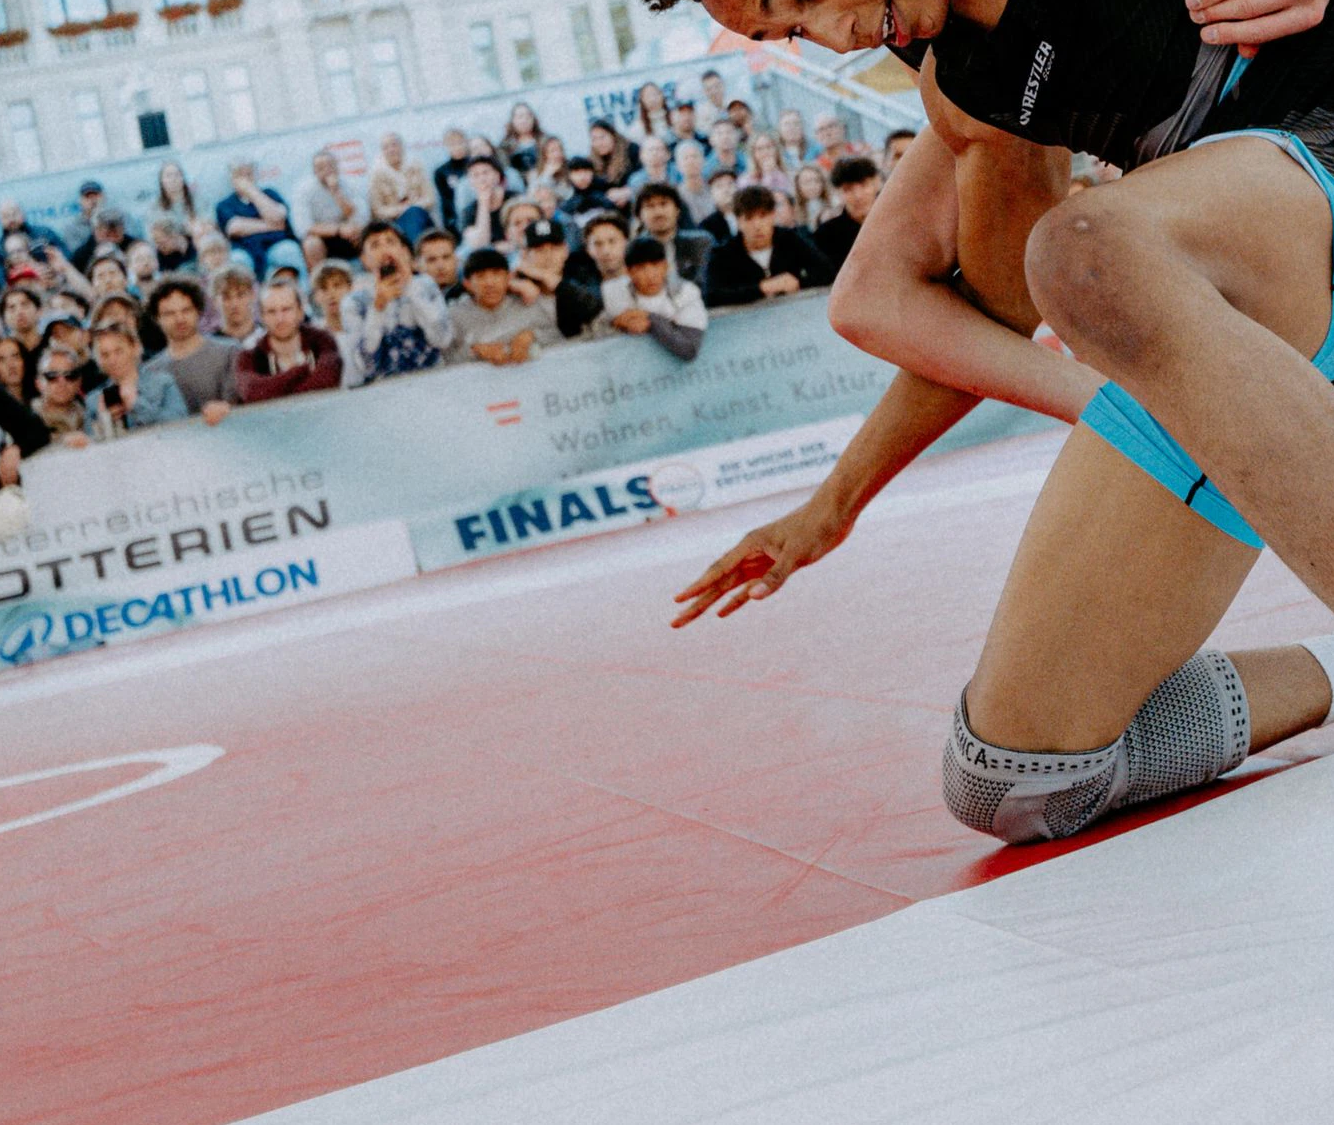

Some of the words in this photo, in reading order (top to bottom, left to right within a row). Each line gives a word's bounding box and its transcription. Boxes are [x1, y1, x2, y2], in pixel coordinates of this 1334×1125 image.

[1019, 41, 1052, 125] WRESTLER
[543, 342, 819, 418] Bundesministerium
[455, 476, 659, 550] FINALS
[64, 559, 319, 642] DECATHLON
